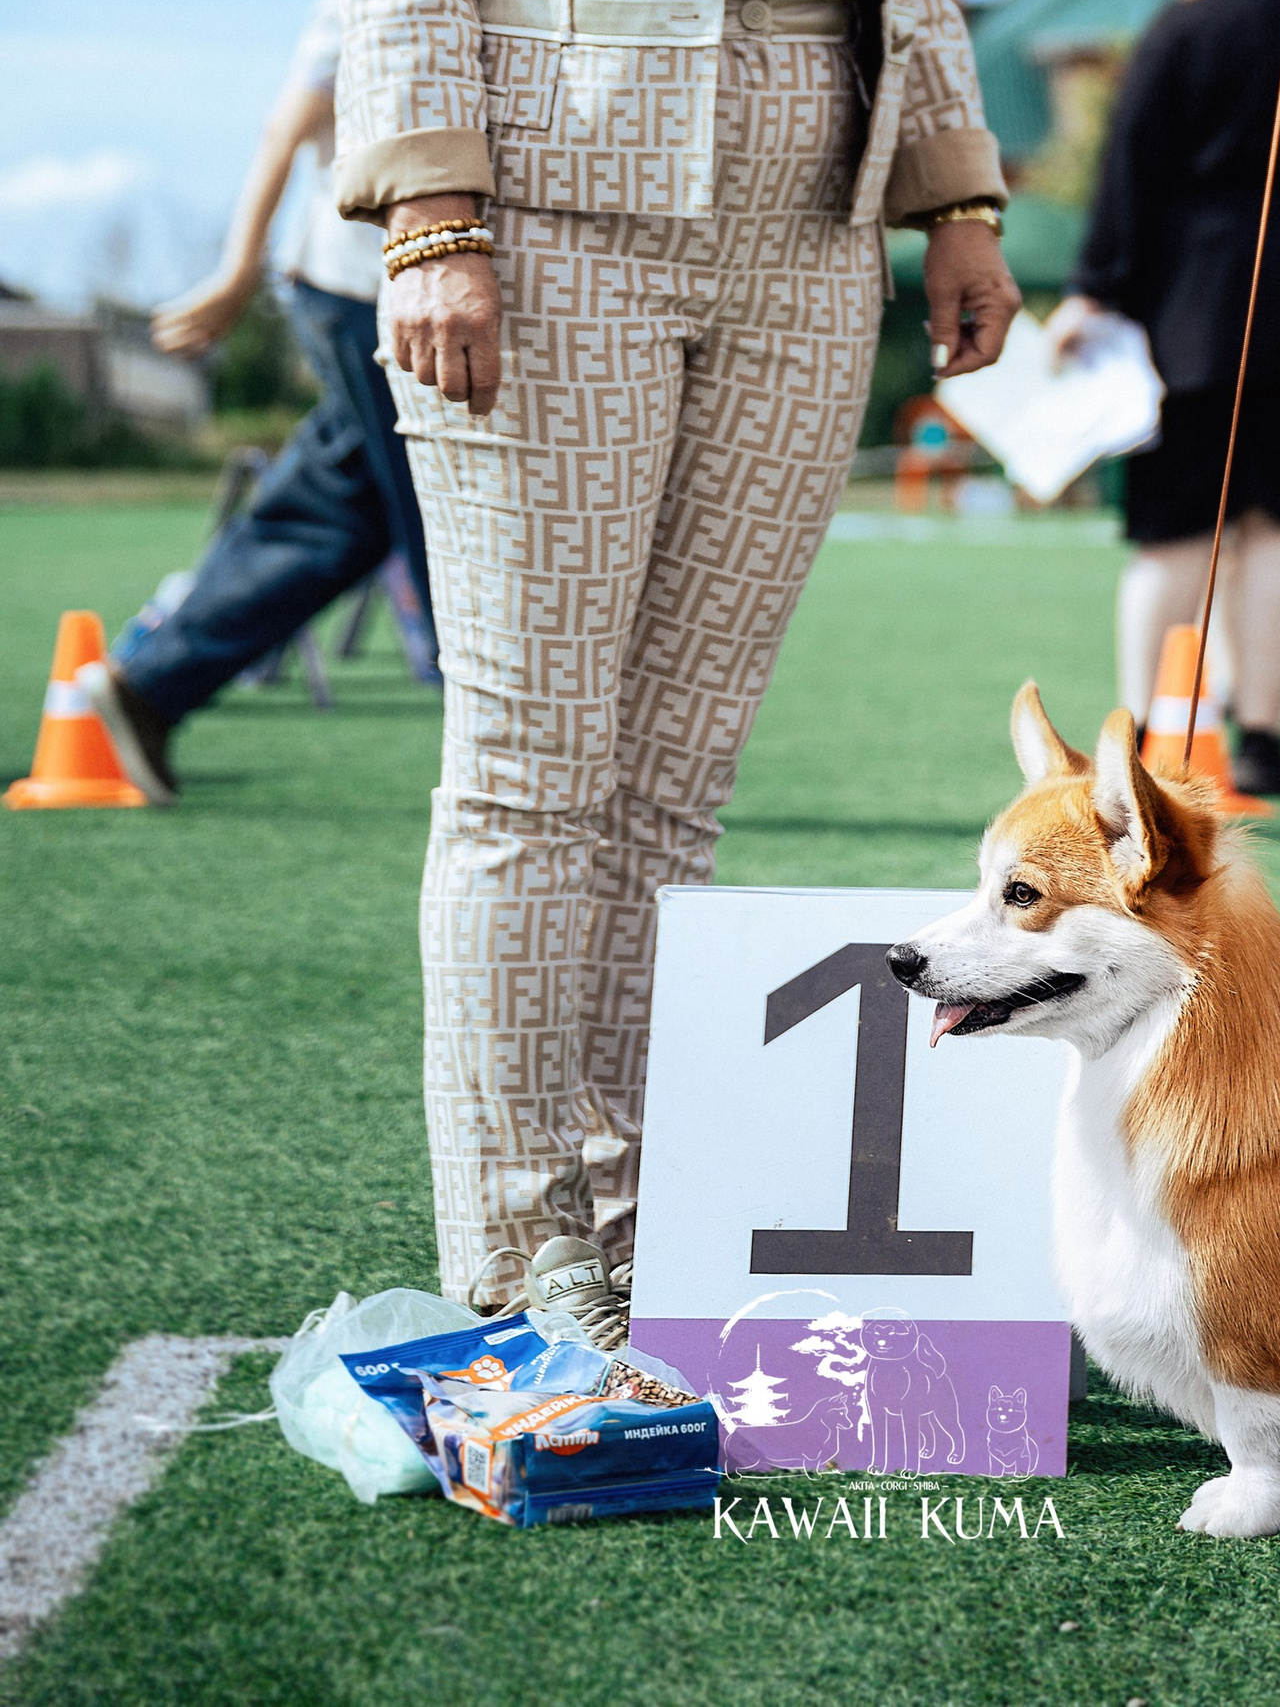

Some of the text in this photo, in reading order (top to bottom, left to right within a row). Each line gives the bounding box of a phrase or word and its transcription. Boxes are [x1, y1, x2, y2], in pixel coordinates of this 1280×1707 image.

[749, 942, 974, 1277] 1
[354, 1362, 391, 1377] 600
[535, 1431, 600, 1450] Лаппи
[624, 1424, 679, 1440] ИНДЕЙКА
